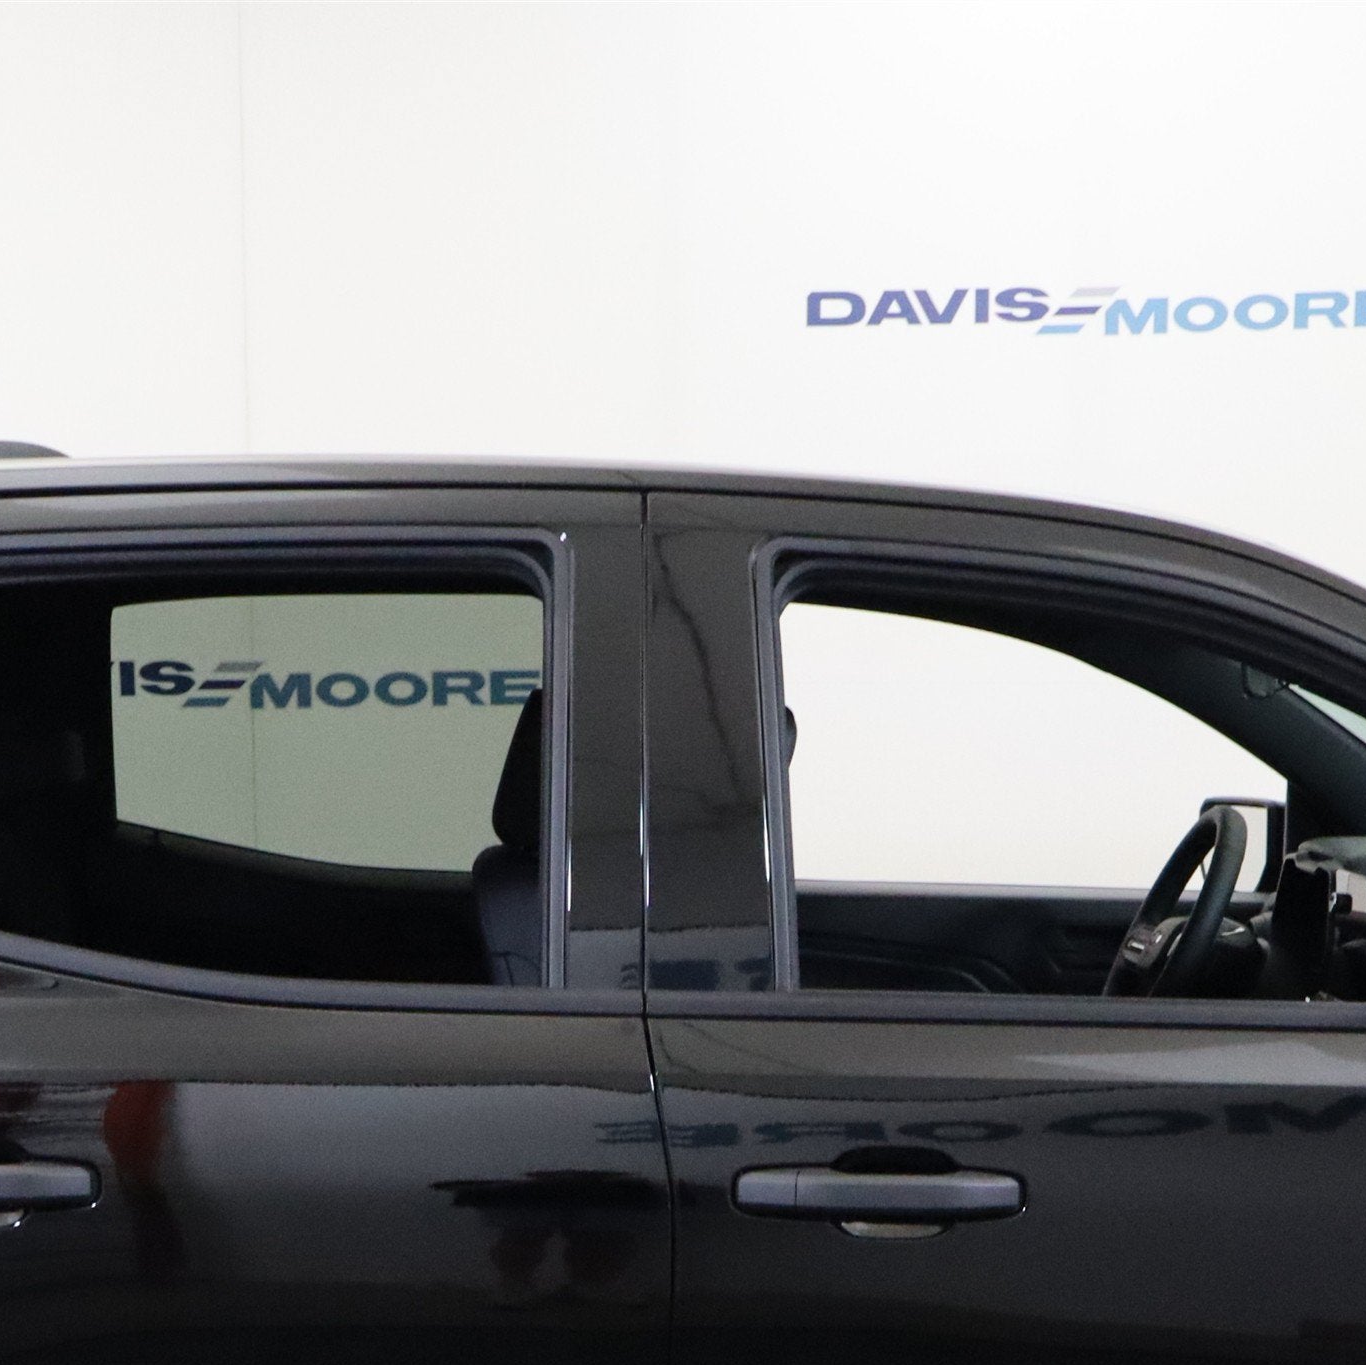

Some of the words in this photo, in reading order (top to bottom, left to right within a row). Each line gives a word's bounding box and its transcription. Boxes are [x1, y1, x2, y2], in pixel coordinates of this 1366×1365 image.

[806, 286, 1051, 327] DAVIS
[113, 660, 195, 697] IS
[249, 669, 541, 709] MOORE
